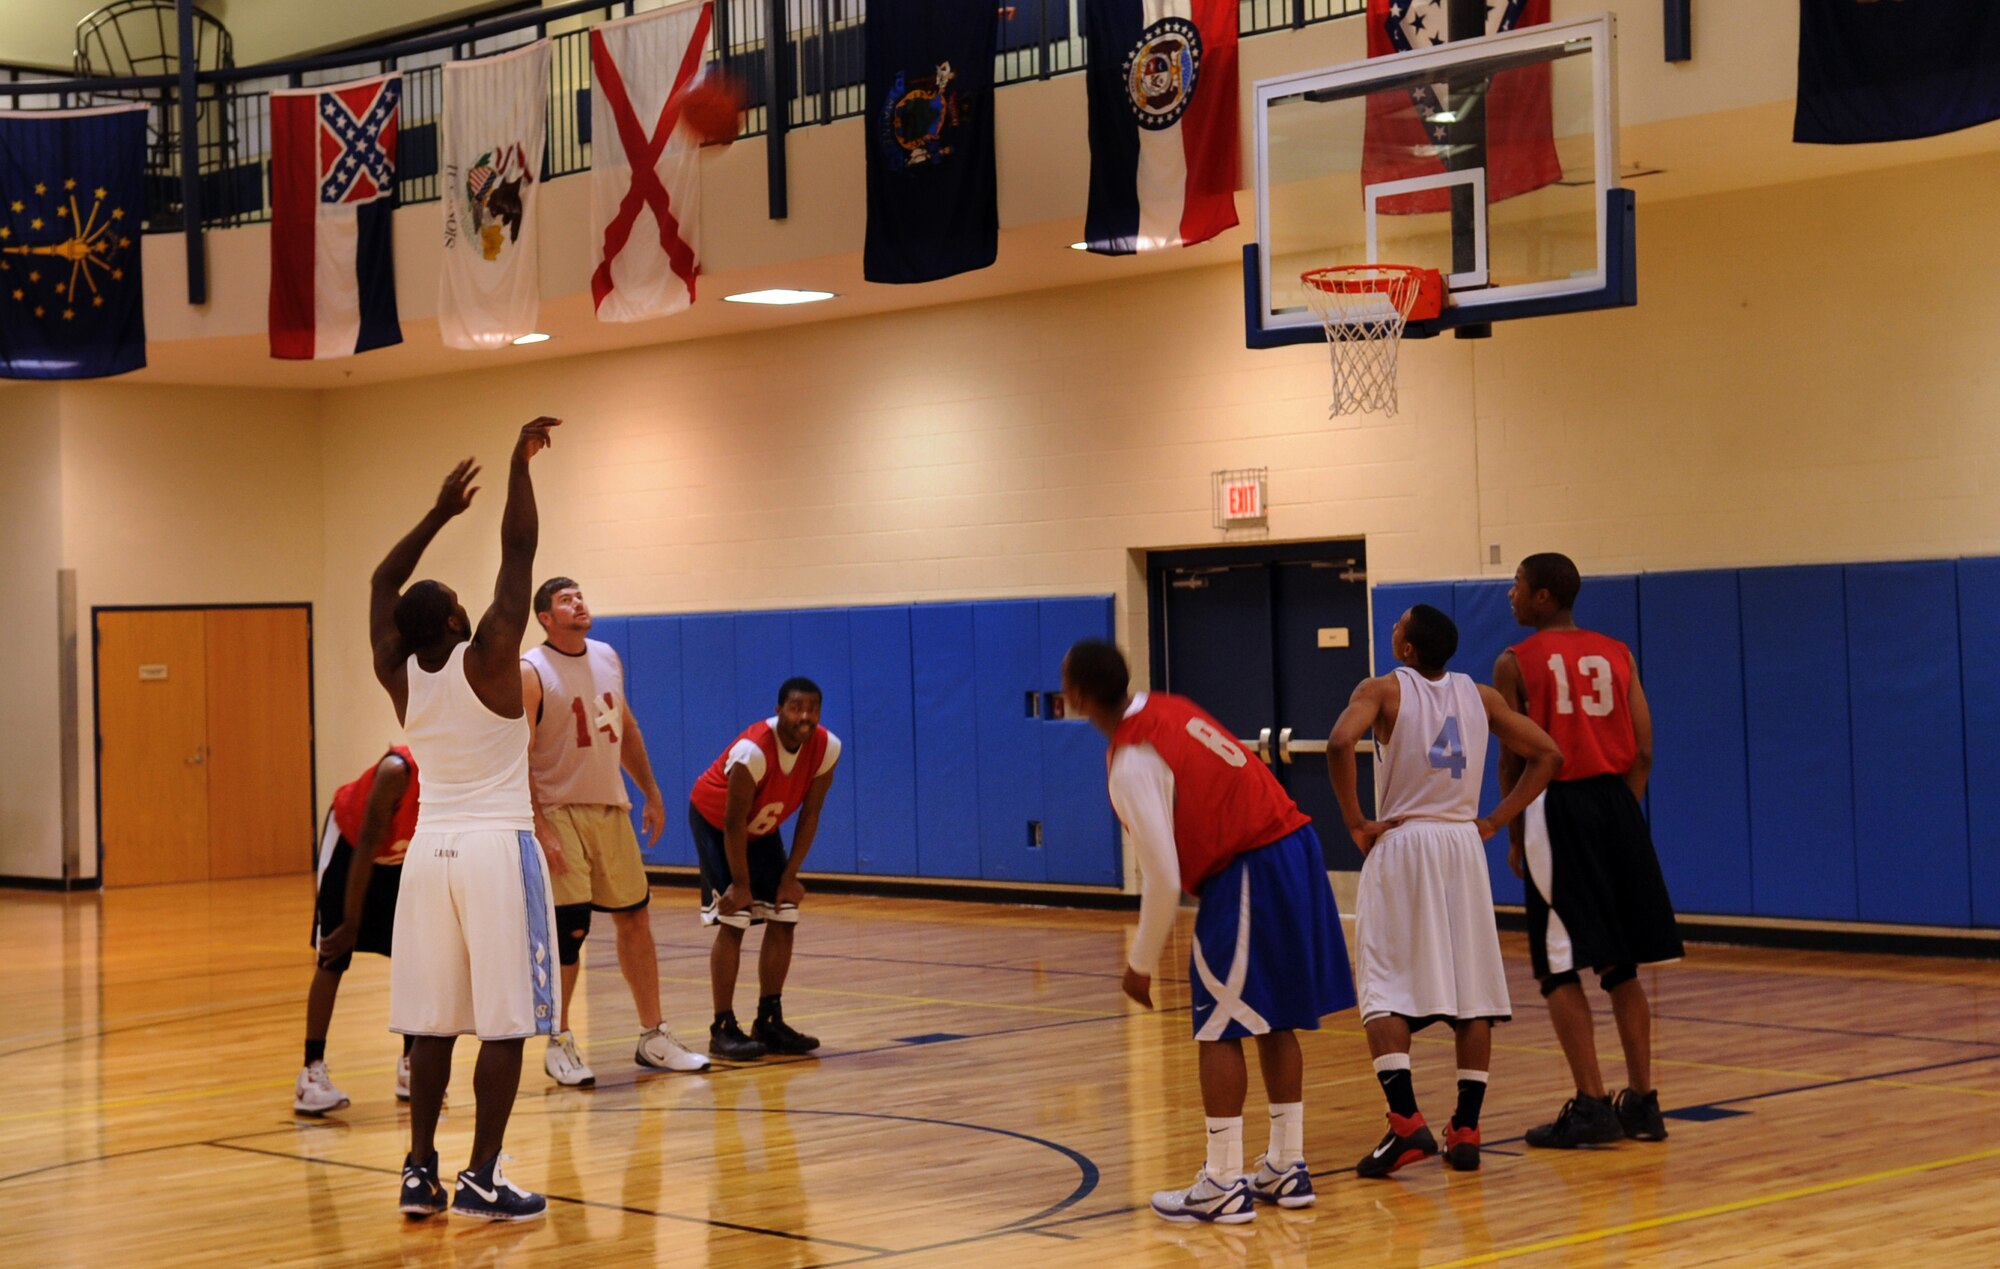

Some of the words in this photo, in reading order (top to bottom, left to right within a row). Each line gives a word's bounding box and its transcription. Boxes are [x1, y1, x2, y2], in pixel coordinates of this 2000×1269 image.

[1229, 486, 1256, 514] EXIT
[1547, 653, 1614, 716] 13
[1185, 716, 1247, 767] 8
[1428, 716, 1466, 779] 4
[747, 802, 784, 835] 6
